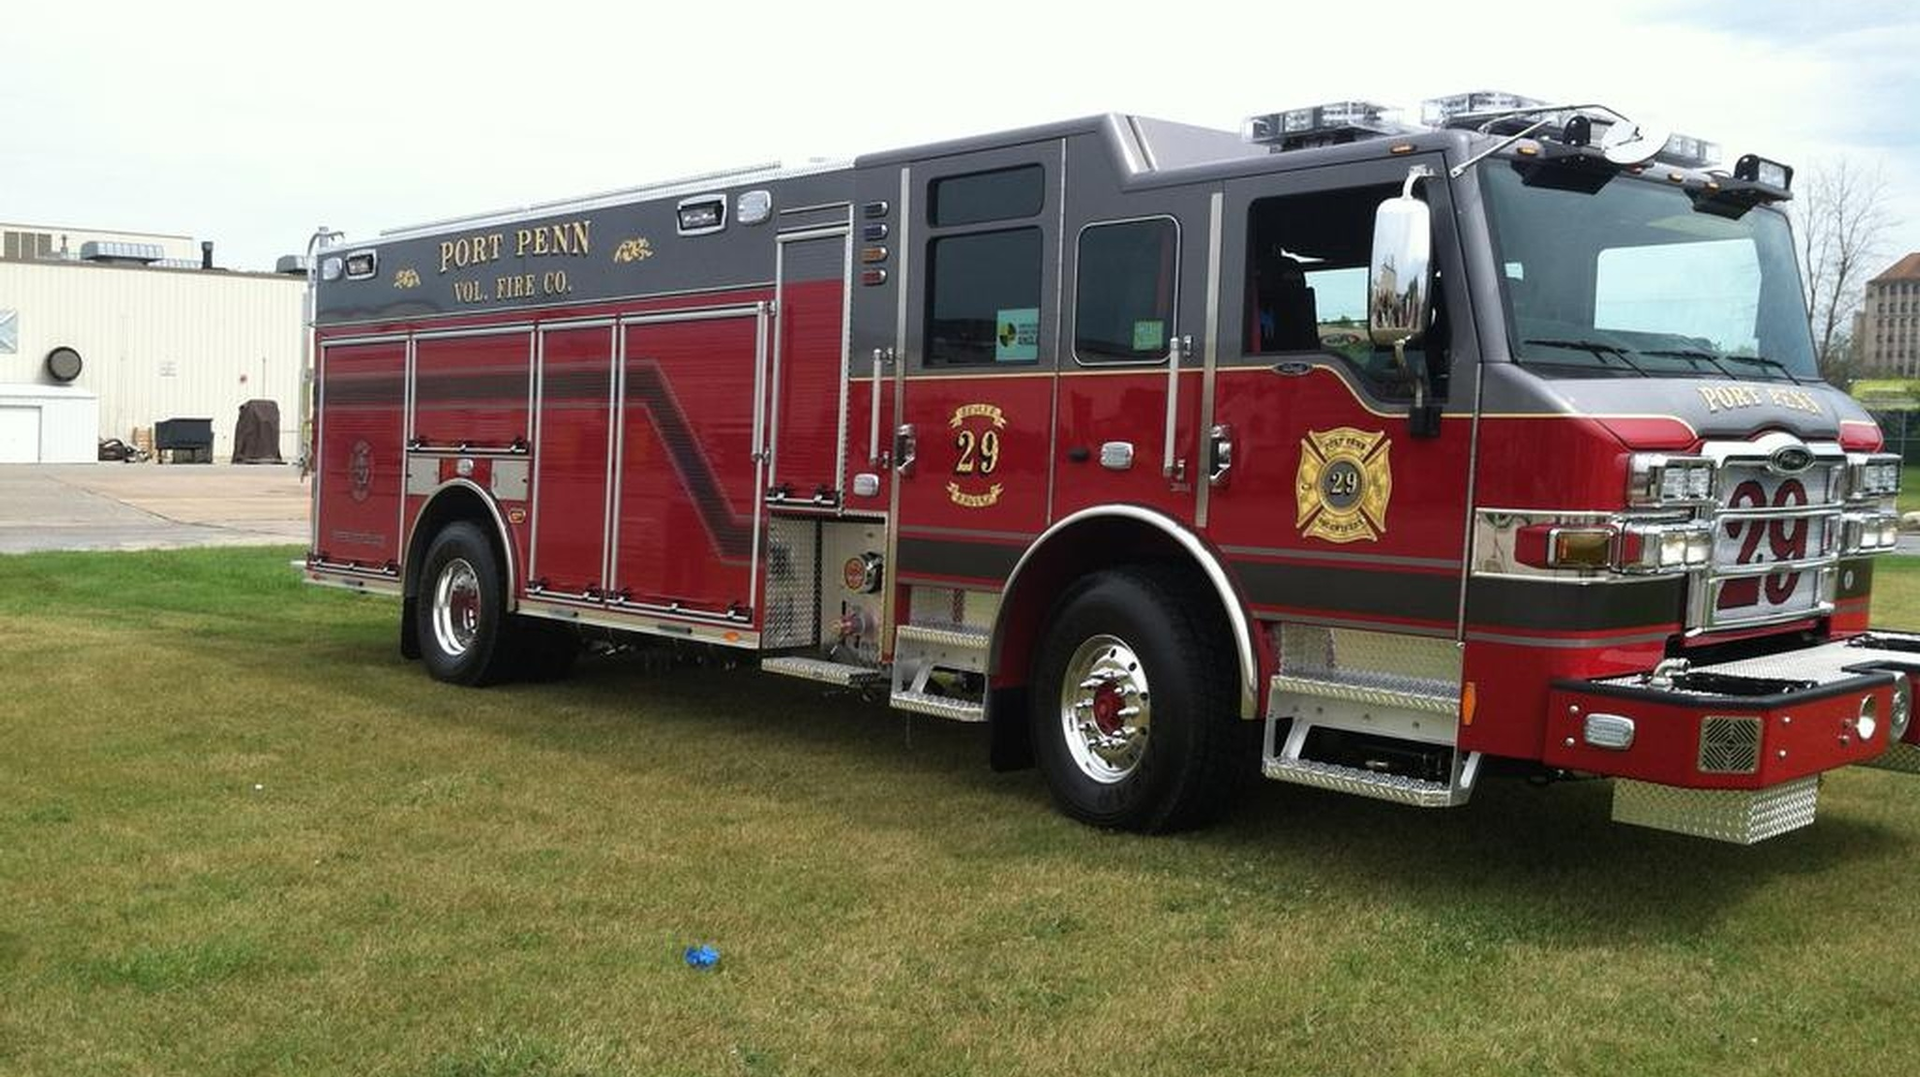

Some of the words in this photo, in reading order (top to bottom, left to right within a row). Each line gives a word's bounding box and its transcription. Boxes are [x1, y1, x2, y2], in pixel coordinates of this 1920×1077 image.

[439, 233, 503, 273] PORT
[516, 220, 591, 256] PENN
[454, 280, 489, 302] VOL.
[497, 274, 536, 299] FIRE
[543, 270, 572, 294] CO.
[1697, 386, 1762, 413] PORT
[956, 430, 999, 474] 29
[1330, 472, 1358, 495] 29
[1716, 477, 1809, 612] 29
